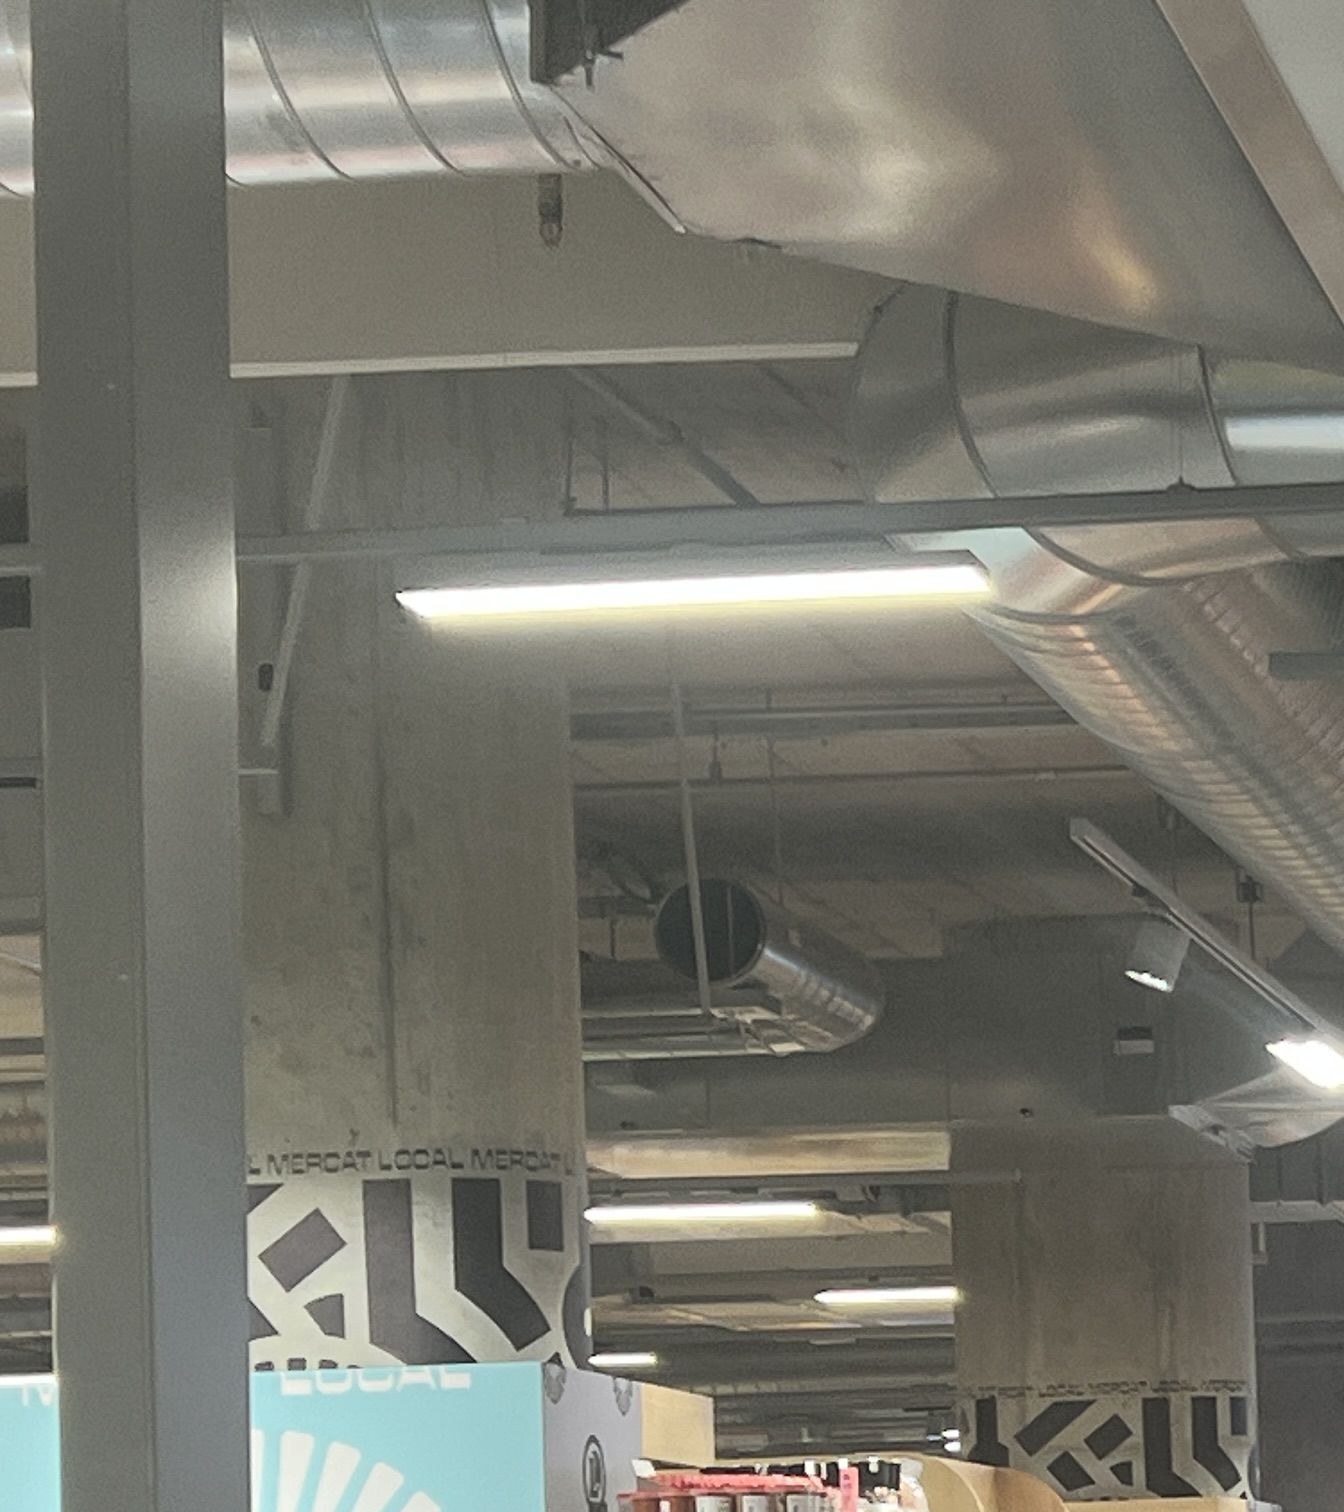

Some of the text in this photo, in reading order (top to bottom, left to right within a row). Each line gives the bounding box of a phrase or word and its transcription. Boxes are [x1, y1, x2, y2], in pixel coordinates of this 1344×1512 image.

[267, 1151, 371, 1175] MERCAT
[379, 1149, 464, 1171] LOCAL
[471, 1149, 560, 1171] MERCAT
